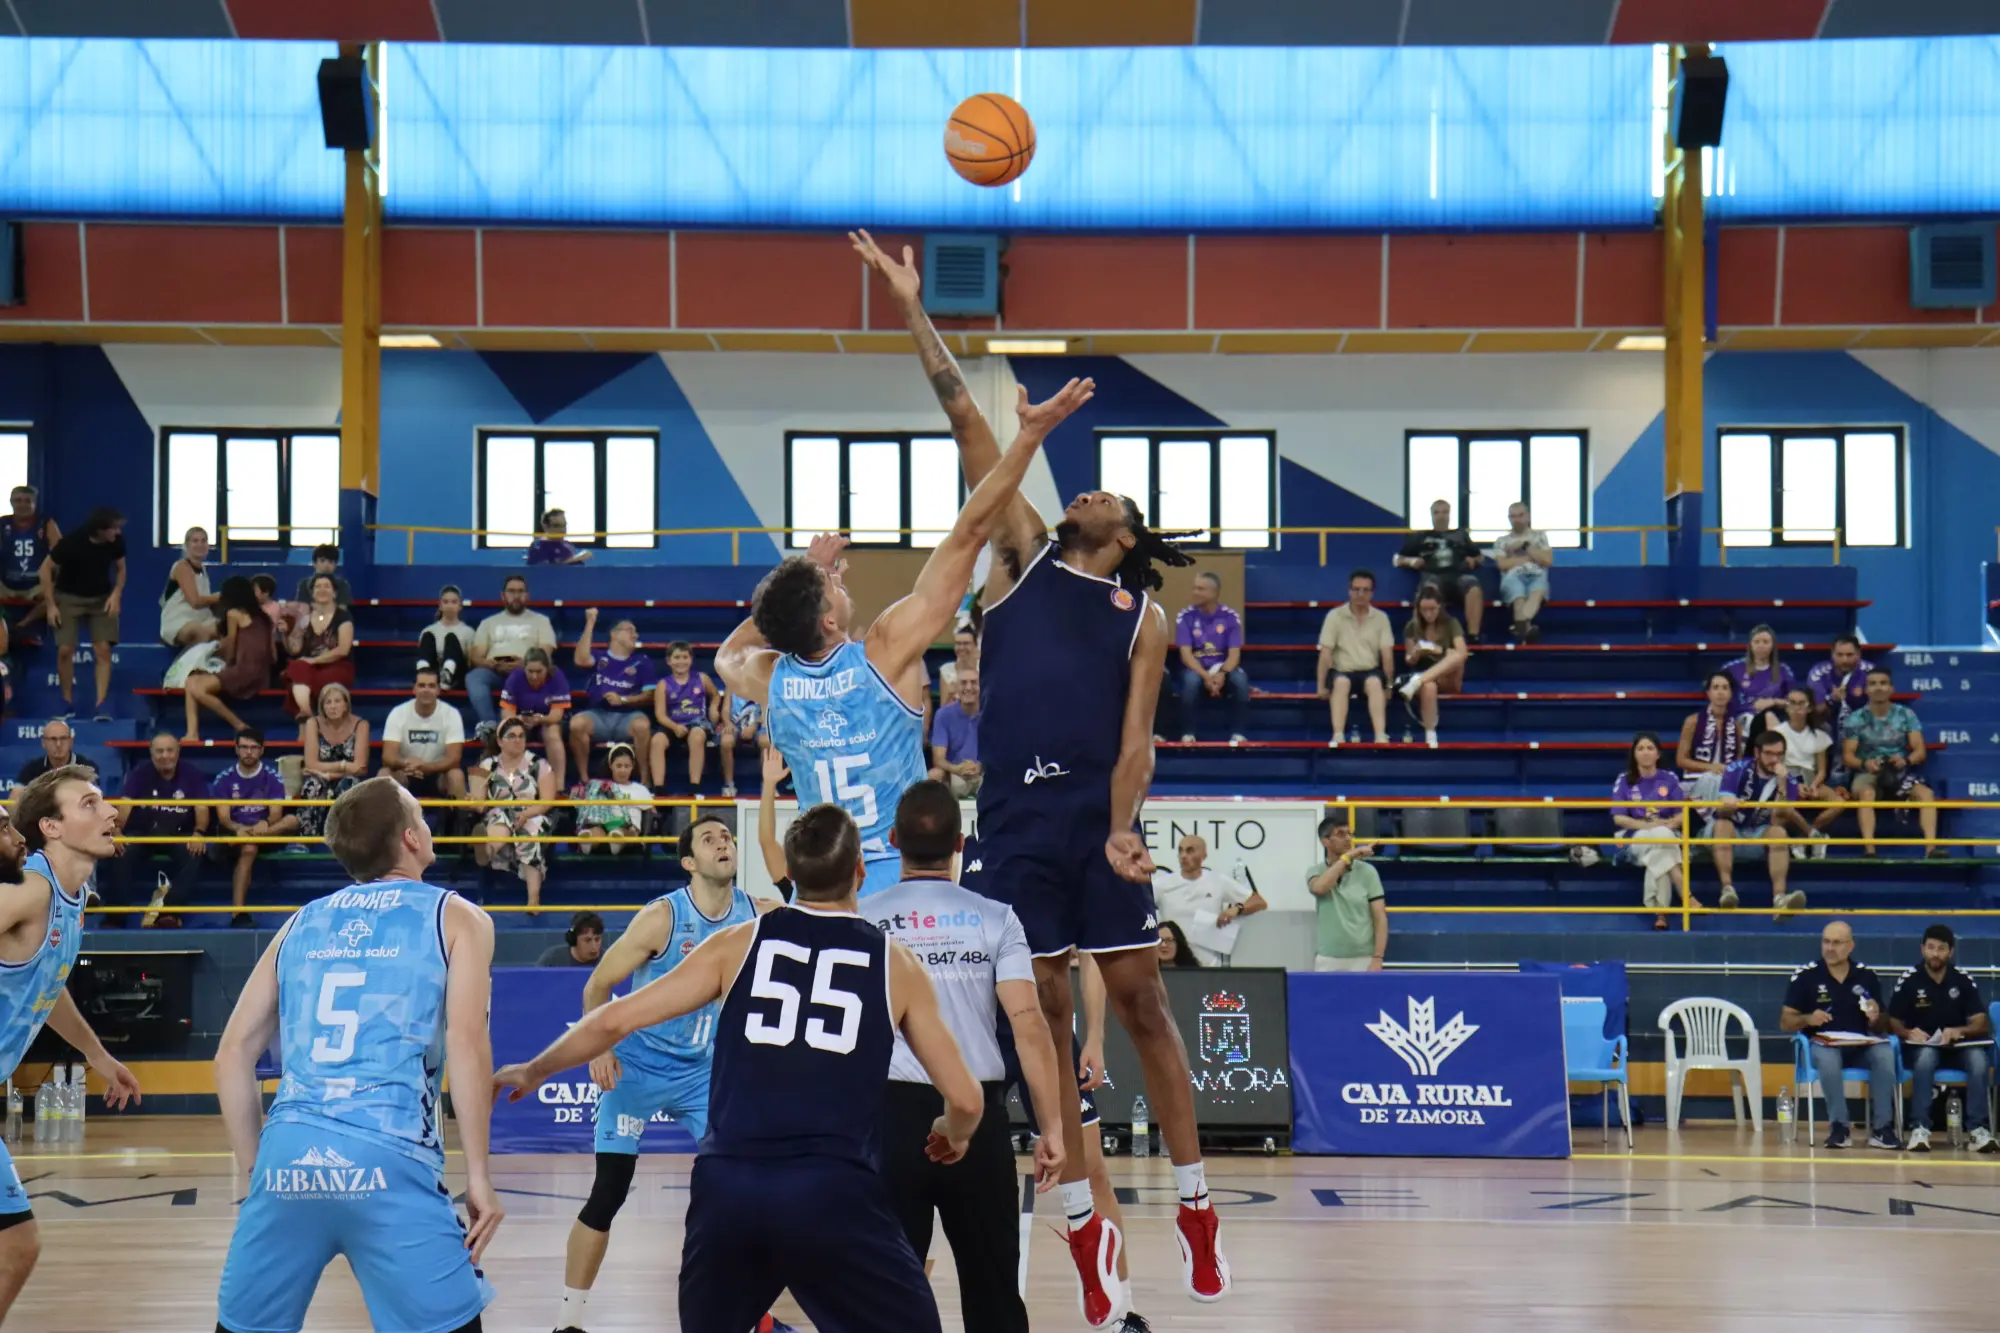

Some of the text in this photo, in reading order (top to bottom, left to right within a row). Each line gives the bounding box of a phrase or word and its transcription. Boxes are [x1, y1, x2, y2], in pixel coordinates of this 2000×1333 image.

[14, 539, 34, 557] 35
[849, 729, 876, 745] salud
[813, 752, 879, 829] 15
[1143, 820, 1266, 850] ENTO
[878, 910, 982, 932] atiendo
[306, 945, 400, 960] recoletas salud
[927, 951, 957, 966] 847
[959, 950, 991, 965] 484
[744, 939, 870, 1055] 55
[311, 971, 367, 1063] 5
[1341, 1083, 1513, 1106] CAJA RURAL
[554, 1108, 583, 1123] DE
[1360, 1108, 1486, 1125] DE ZAMORA
[265, 1166, 388, 1192] LEBANZA
